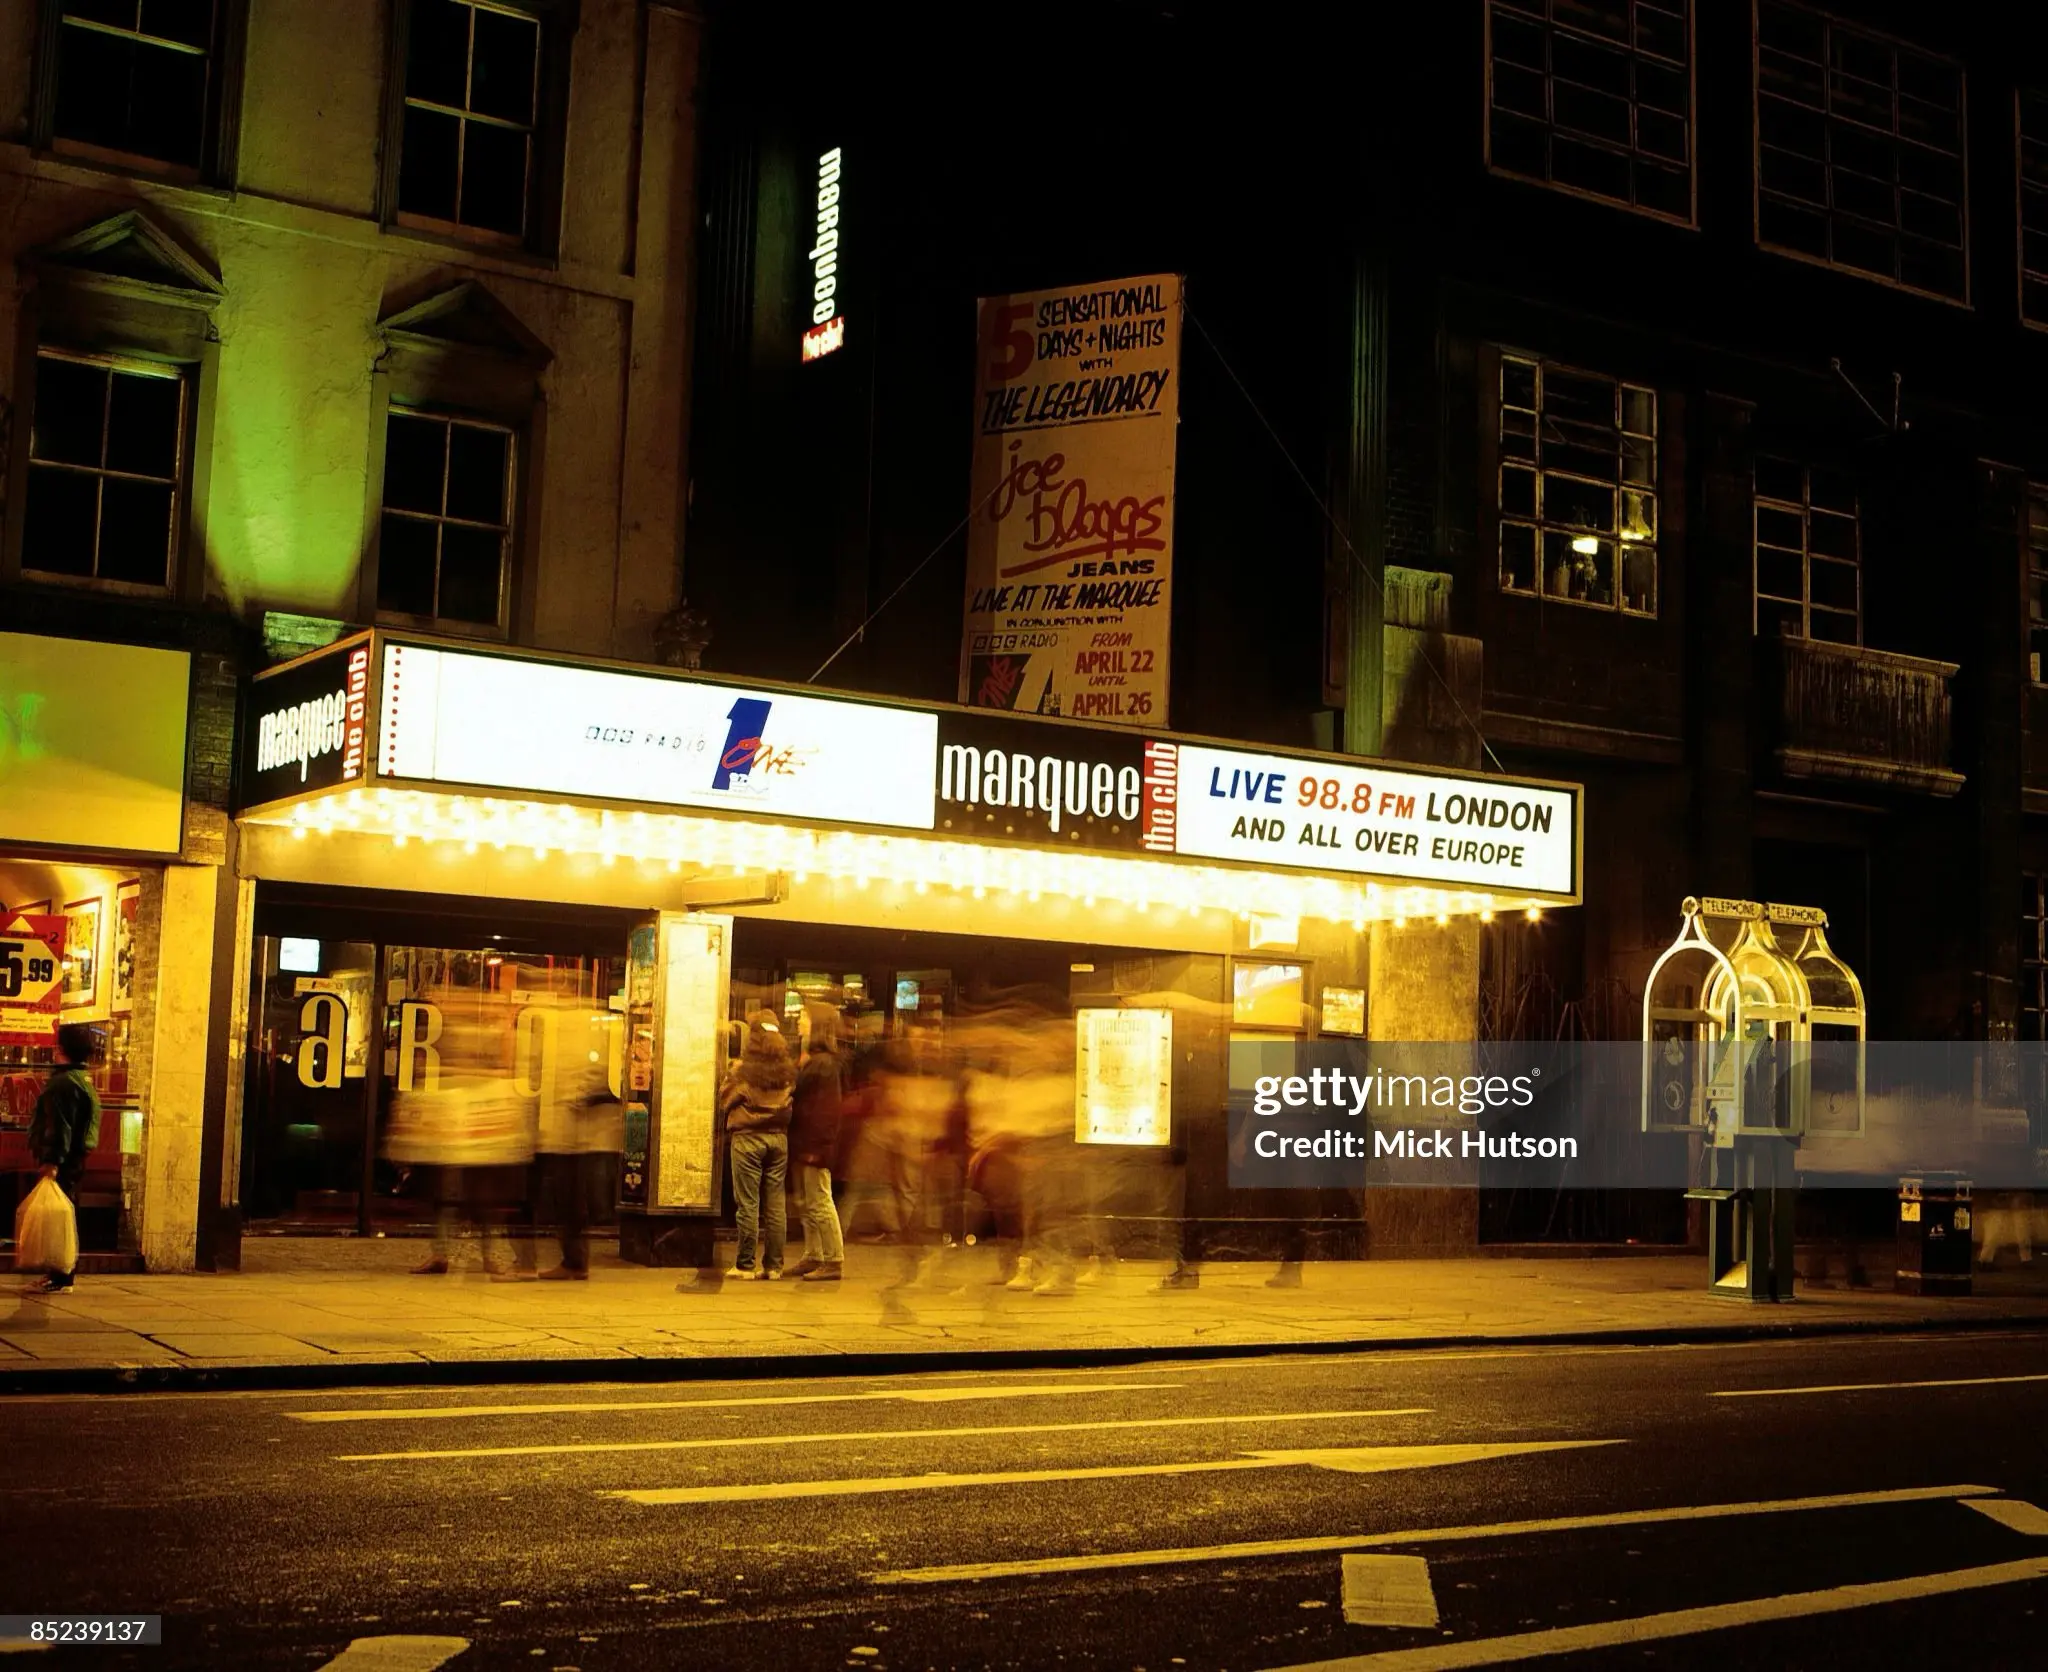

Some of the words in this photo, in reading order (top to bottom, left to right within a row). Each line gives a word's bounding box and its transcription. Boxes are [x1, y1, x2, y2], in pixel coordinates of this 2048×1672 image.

[1037, 284, 1167, 328] SENSATIONAL
[988, 301, 1035, 382] 5
[1037, 328, 1083, 361] DAYS
[1098, 318, 1166, 353] NIGHTS
[1079, 357, 1113, 372] WITH
[982, 386, 1028, 429] THE
[1024, 368, 1170, 423] LEGENDARY
[989, 439, 1065, 522] joe
[1067, 559, 1155, 578] JEANS
[970, 585, 1013, 613] LIVE
[1011, 585, 1041, 613] AT
[1041, 584, 1076, 611] THE
[1073, 578, 1166, 612] MARQUEE
[1007, 618, 1017, 628] IN
[1096, 615, 1124, 626] WITH
[1020, 633, 1059, 649] RADIO
[1090, 632, 1133, 648] FROM
[1075, 652, 1127, 675] APRIL
[1130, 650, 1154, 673] 22
[1088, 674, 1127, 687] UNTIL
[1072, 693, 1123, 717] APRIL
[1127, 692, 1152, 715] 26
[1144, 741, 1177, 804] club
[1209, 766, 1286, 804] LIVE
[1297, 776, 1372, 815] 98.8
[1379, 793, 1416, 820] FM
[1426, 792, 1553, 834] LONDON
[1143, 808, 1175, 851] the
[1231, 816, 1285, 843] AND
[1298, 823, 1342, 849] ALL
[1355, 828, 1419, 857] OVER
[1431, 837, 1525, 868] EUROPE
